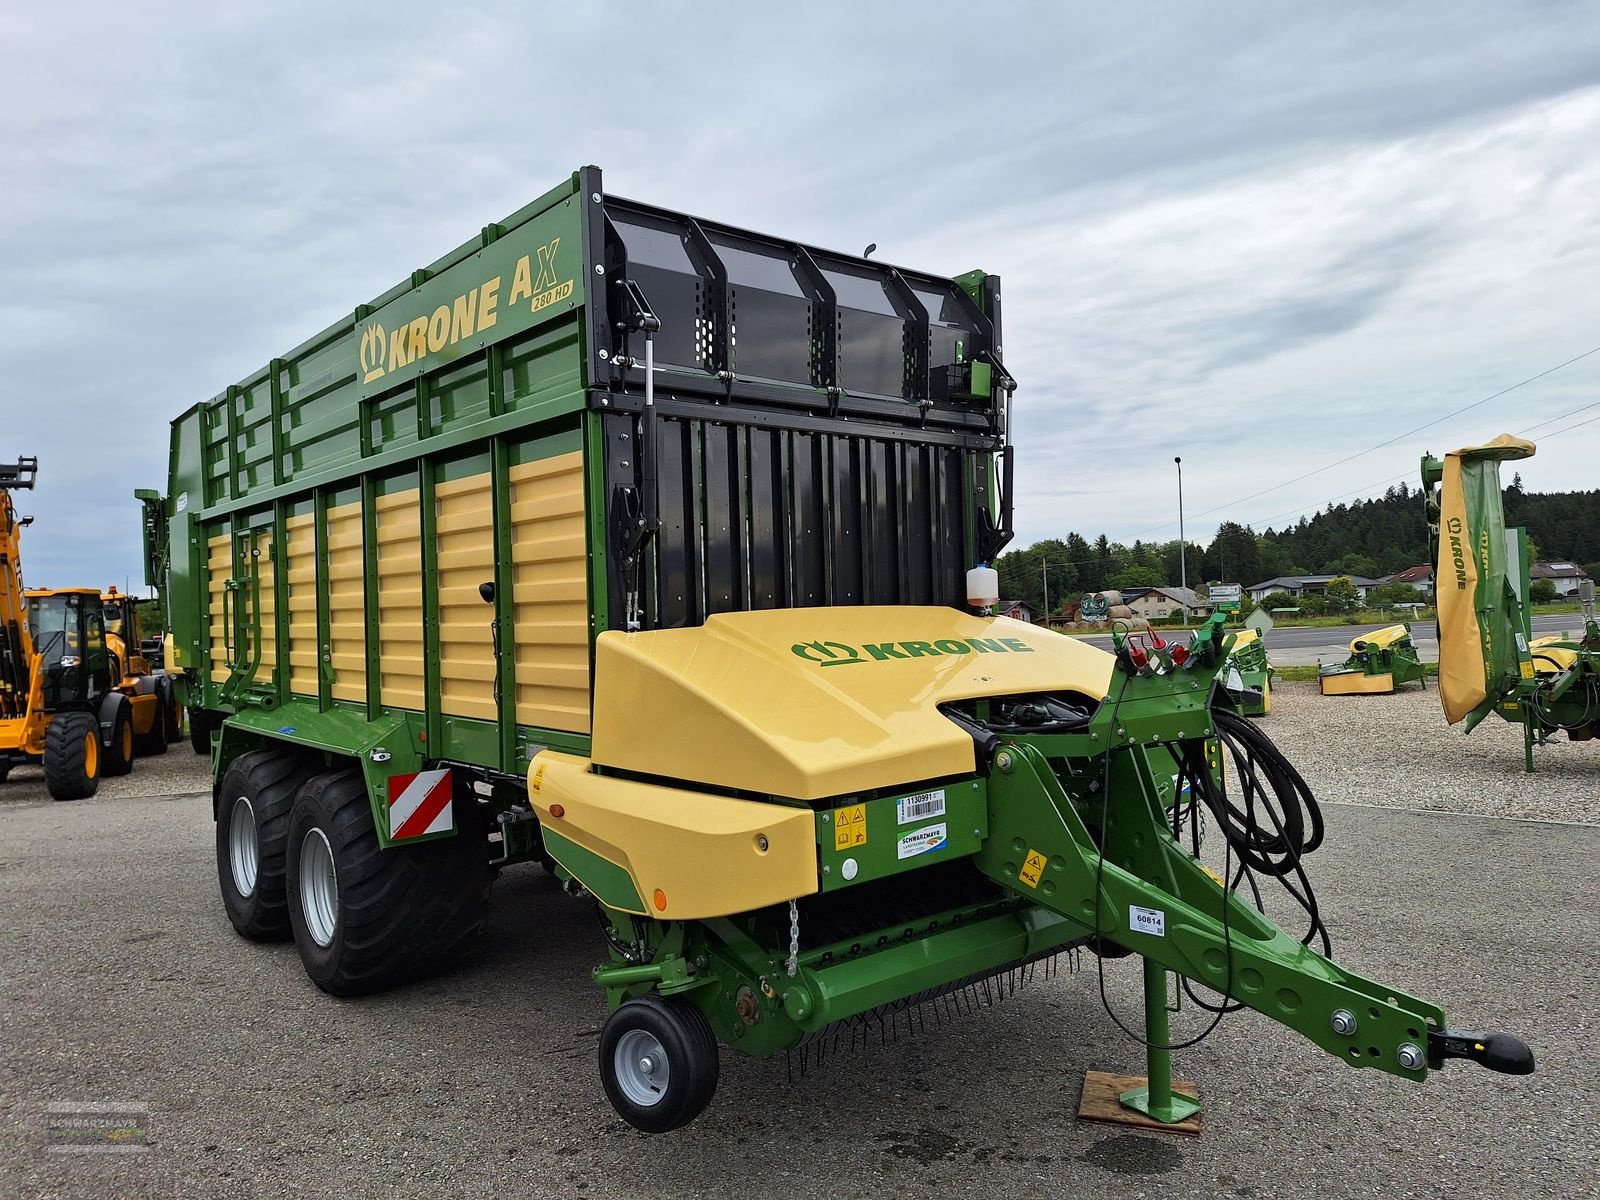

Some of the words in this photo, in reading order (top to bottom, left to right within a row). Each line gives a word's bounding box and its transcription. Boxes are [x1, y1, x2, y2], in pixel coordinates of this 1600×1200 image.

[388, 276, 501, 373] KRONE
[508, 237, 561, 306] AX
[534, 291, 552, 310] 280
[554, 283, 570, 301] HD
[1450, 536, 1466, 590] KRONE
[862, 638, 1035, 661] KRONE
[908, 793, 932, 805] 1130991
[902, 830, 940, 844] SCHWARZMAYR
[1137, 914, 1161, 926] 60814
